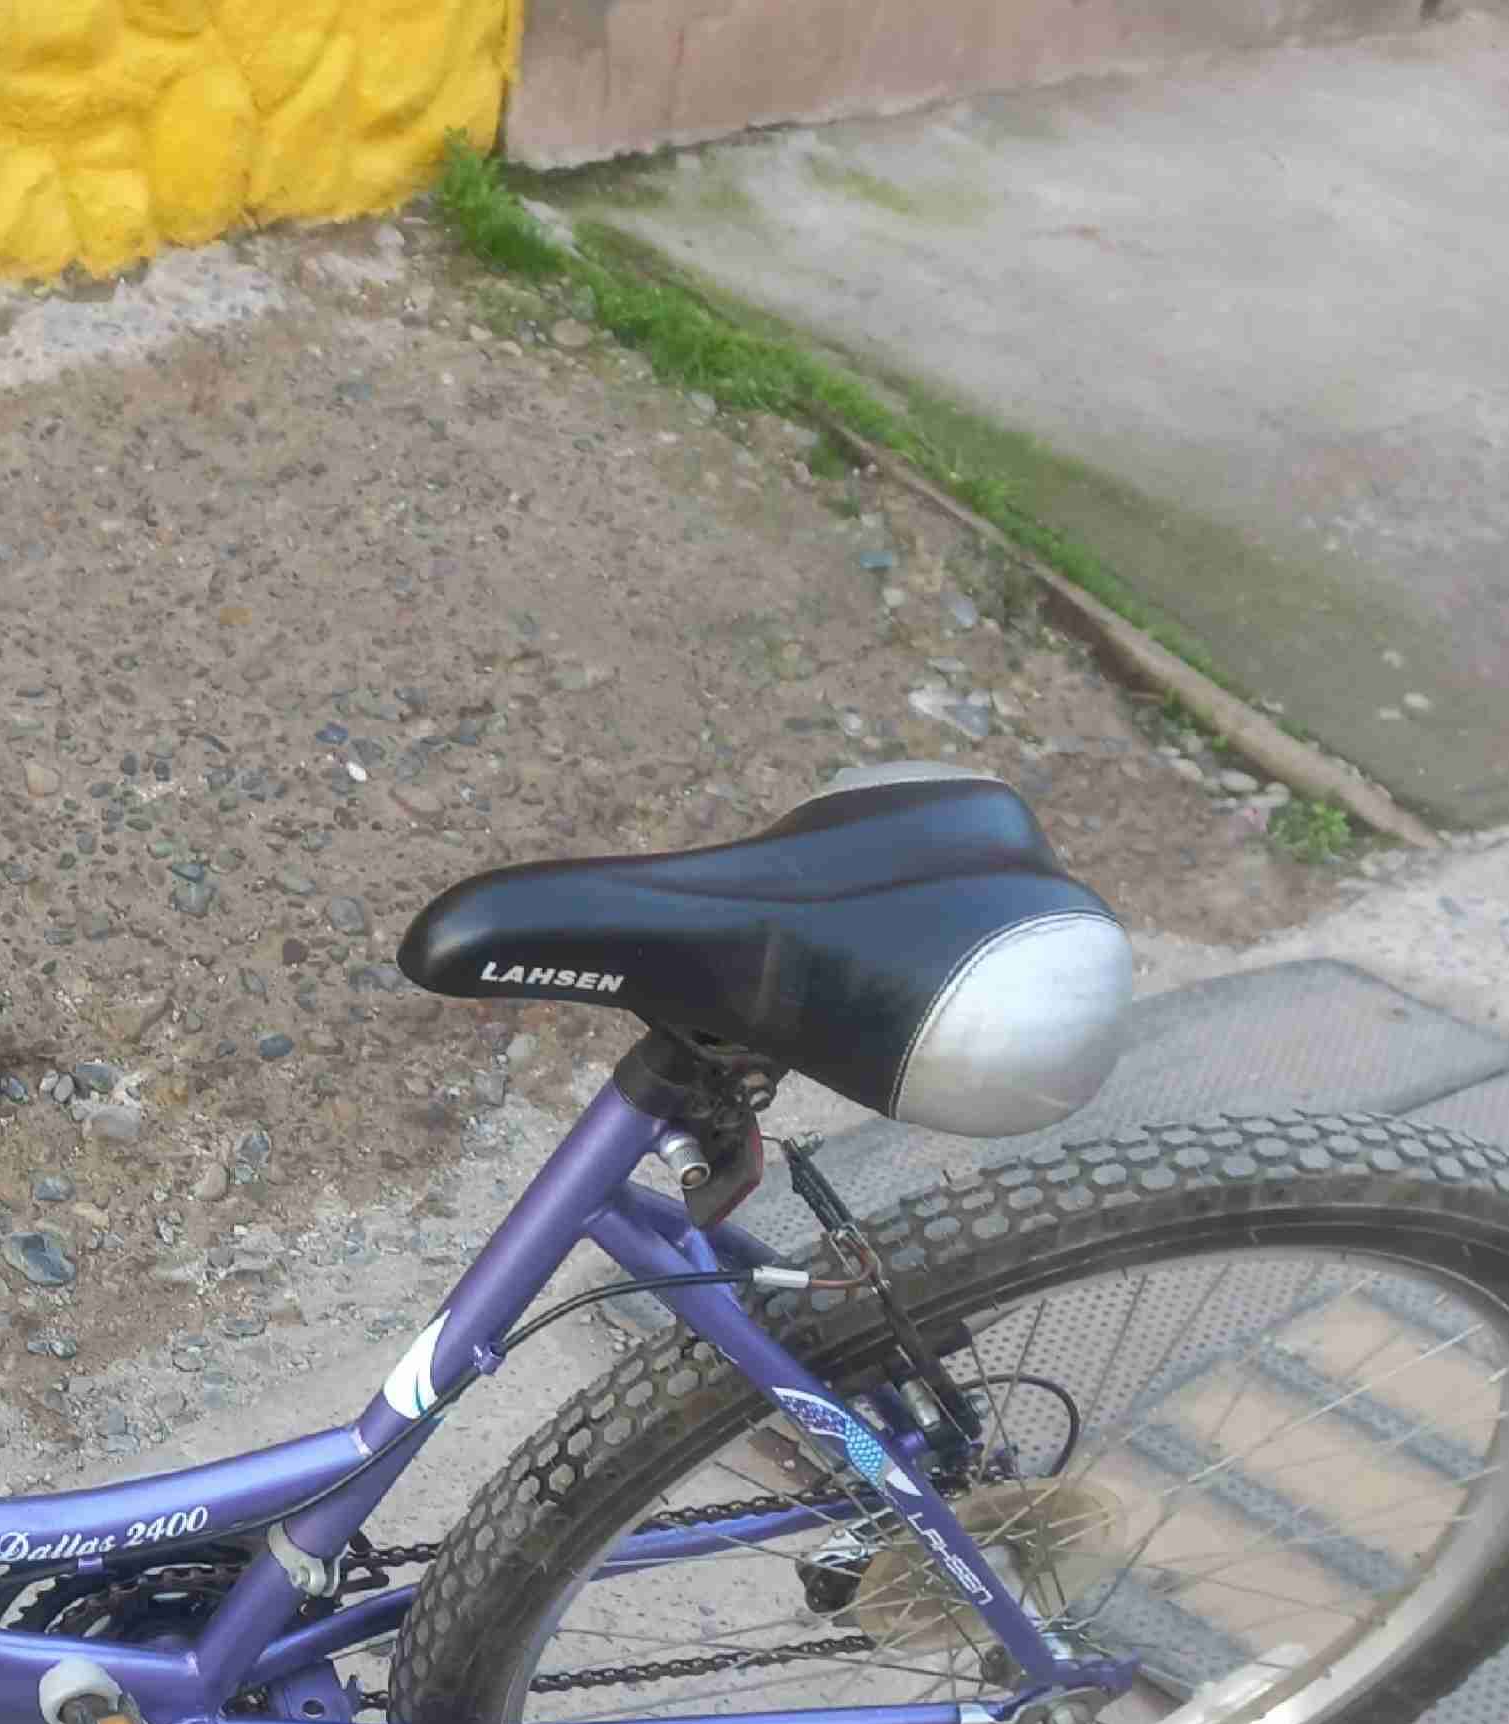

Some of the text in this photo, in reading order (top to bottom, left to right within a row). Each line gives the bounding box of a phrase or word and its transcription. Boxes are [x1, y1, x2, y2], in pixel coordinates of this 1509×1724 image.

[480, 960, 625, 993] LAHSEN
[124, 1505, 209, 1548] 2400
[907, 1512, 994, 1605] LAHSEN
